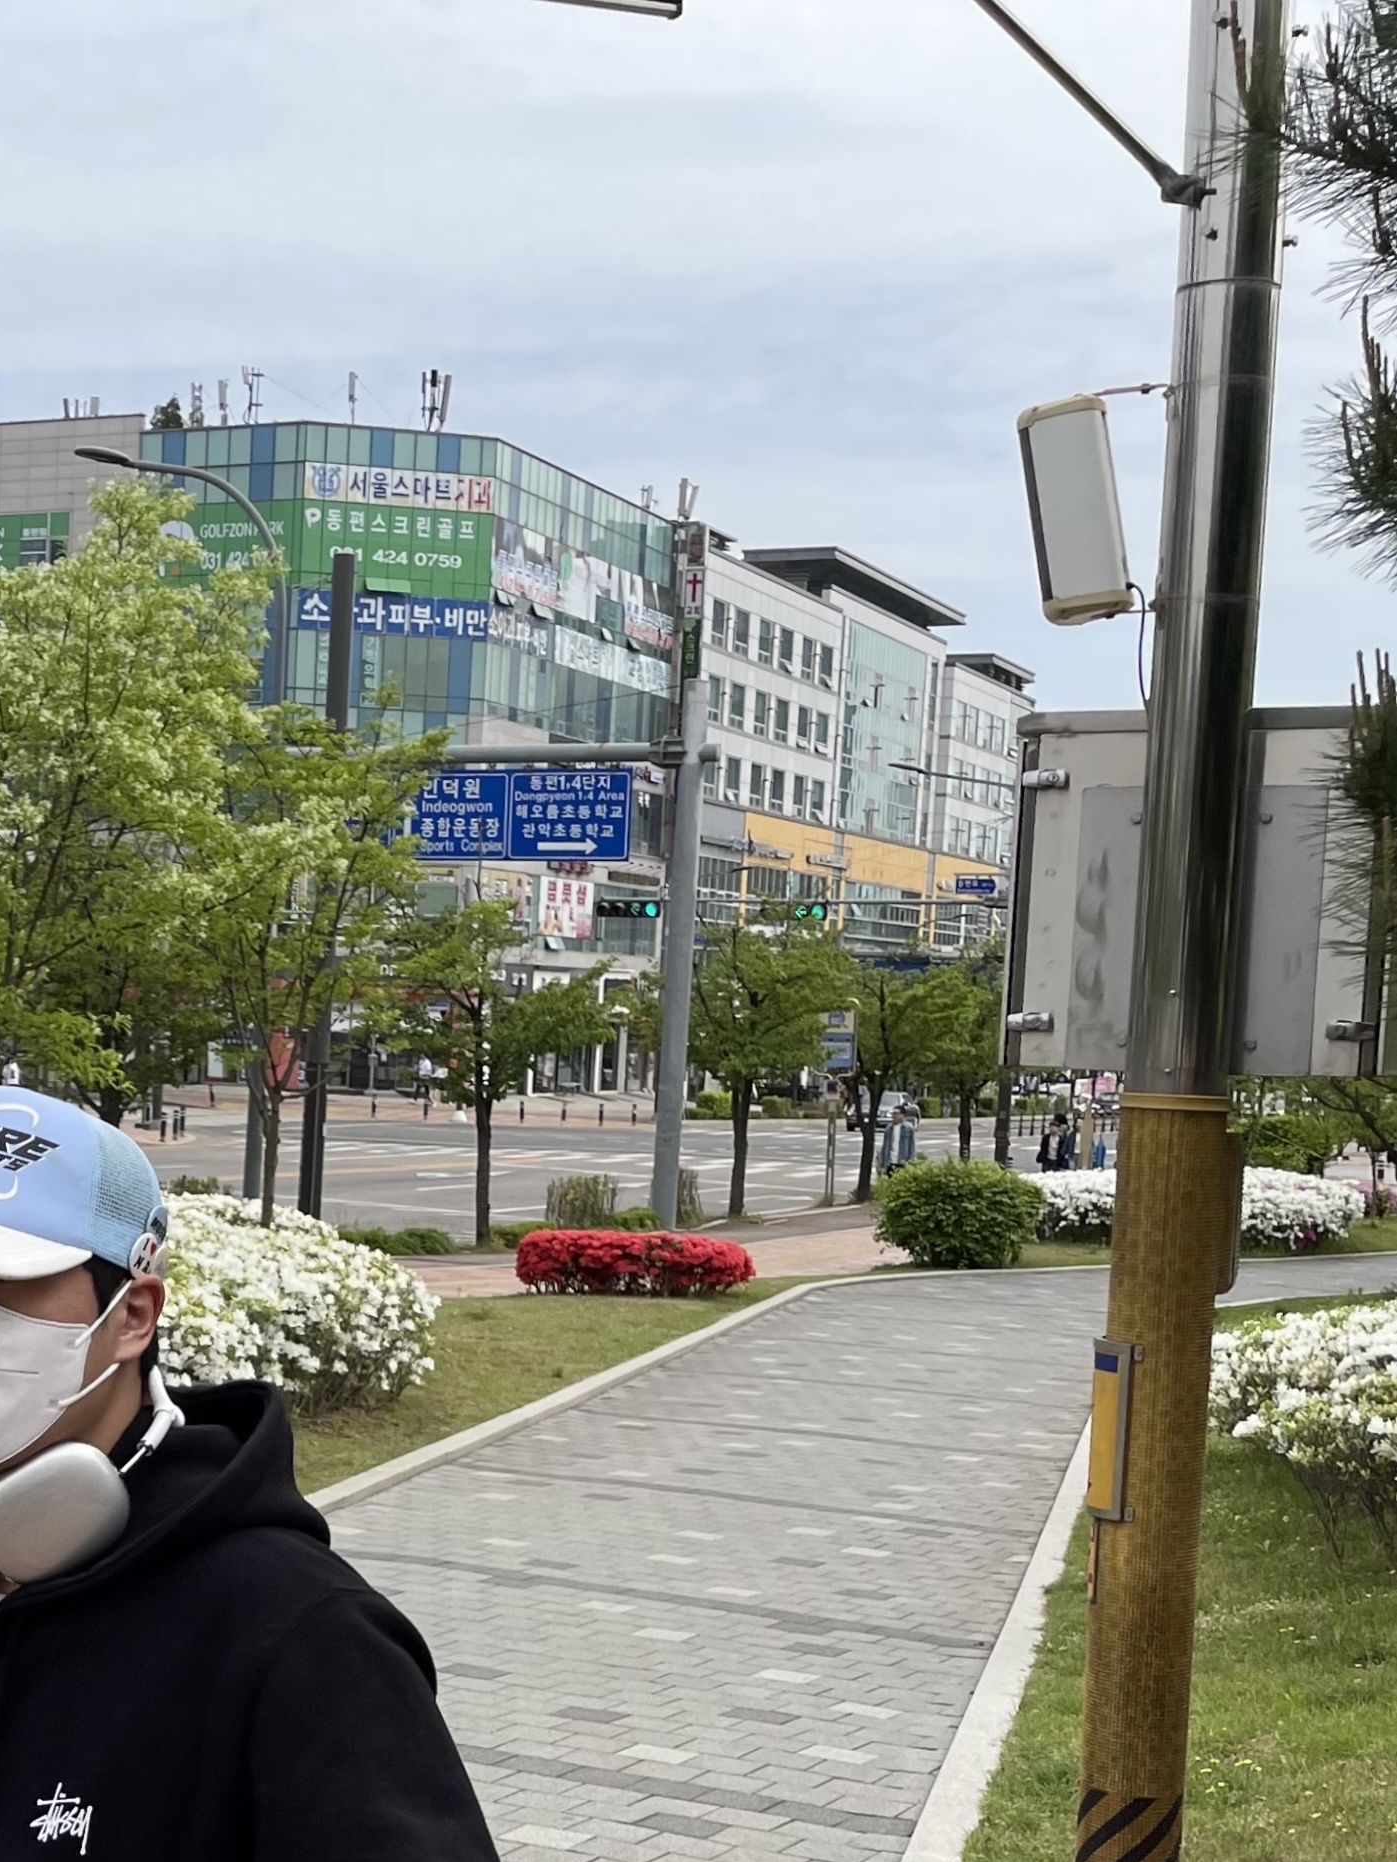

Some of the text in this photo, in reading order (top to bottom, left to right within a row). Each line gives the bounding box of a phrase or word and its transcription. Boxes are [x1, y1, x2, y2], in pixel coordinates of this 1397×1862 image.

[200, 520, 284, 538] GOLFZON PRK
[327, 509, 474, 539] 동편스크린골프
[372, 549, 408, 565] 424
[414, 553, 462, 569] 0759
[422, 778, 481, 799] 인덕원
[515, 791, 575, 802] Dongpyeon
[598, 791, 625, 801] Area
[421, 800, 493, 815] Indeogwon
[515, 804, 624, 819] 해오름초등학교
[420, 817, 500, 838] 종합운동장
[522, 822, 614, 839] 관악초등학교
[420, 839, 454, 853] Sports
